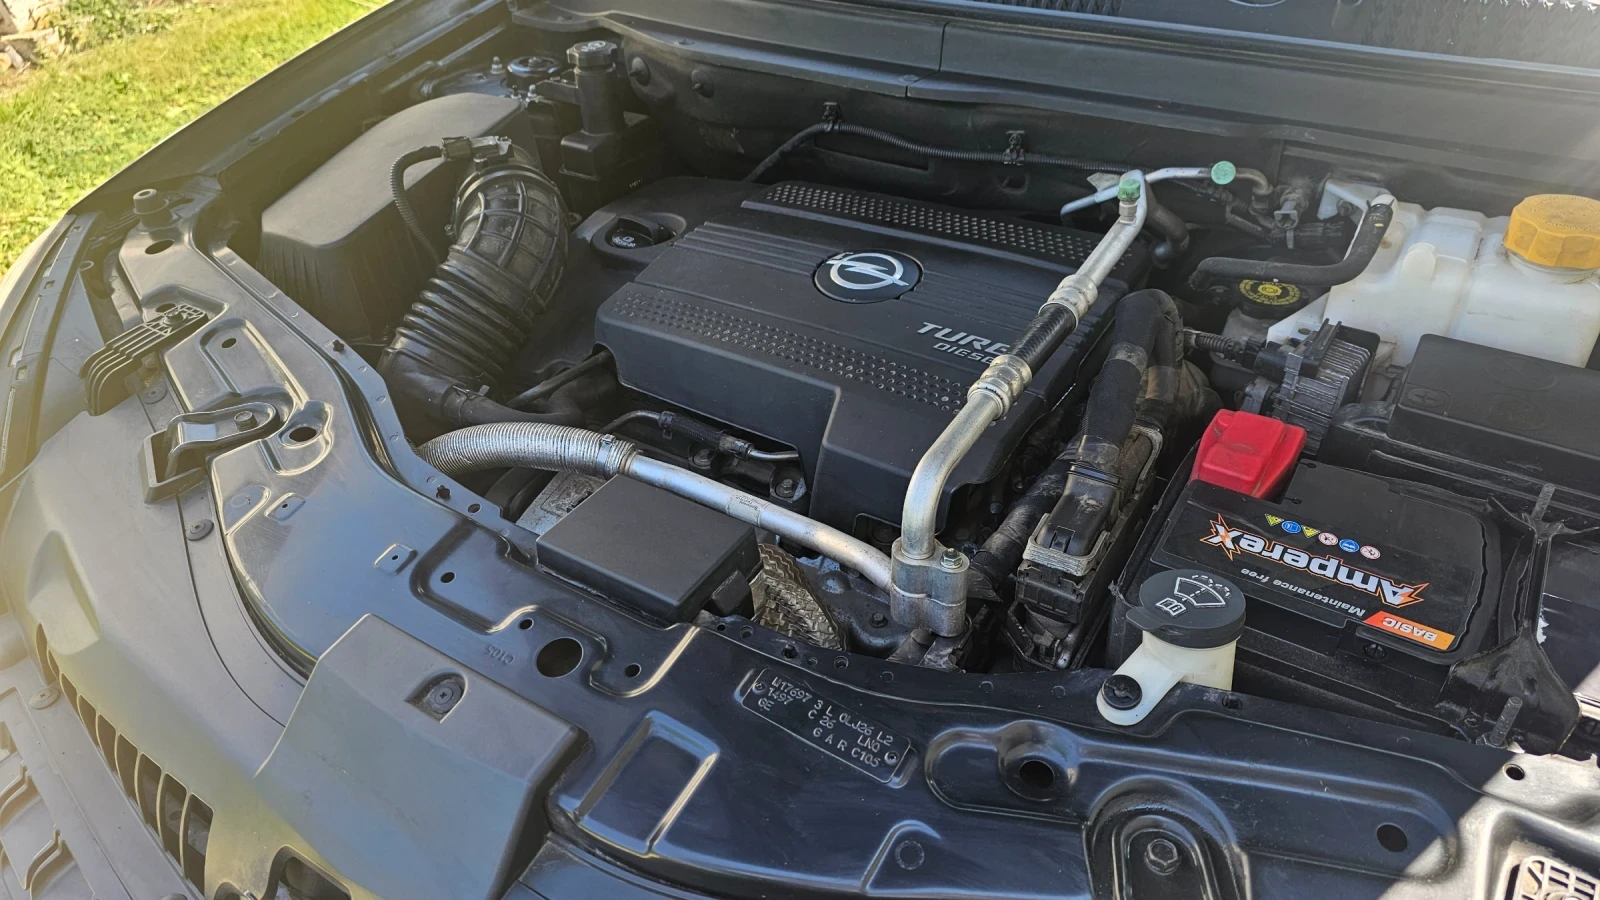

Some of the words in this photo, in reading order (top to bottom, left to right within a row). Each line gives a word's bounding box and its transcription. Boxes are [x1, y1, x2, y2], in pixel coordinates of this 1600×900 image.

[1240, 568, 1270, 584] free
[1273, 580, 1366, 617] Maintenance
[1382, 617, 1438, 642] BASIC
[768, 688, 794, 705] 1497
[808, 709, 818, 719] C
[819, 715, 837, 729] 26
[813, 699, 824, 710] 3
[825, 705, 833, 717] L
[824, 733, 833, 744] A
[836, 739, 848, 751] R
[850, 747, 881, 768] C105
